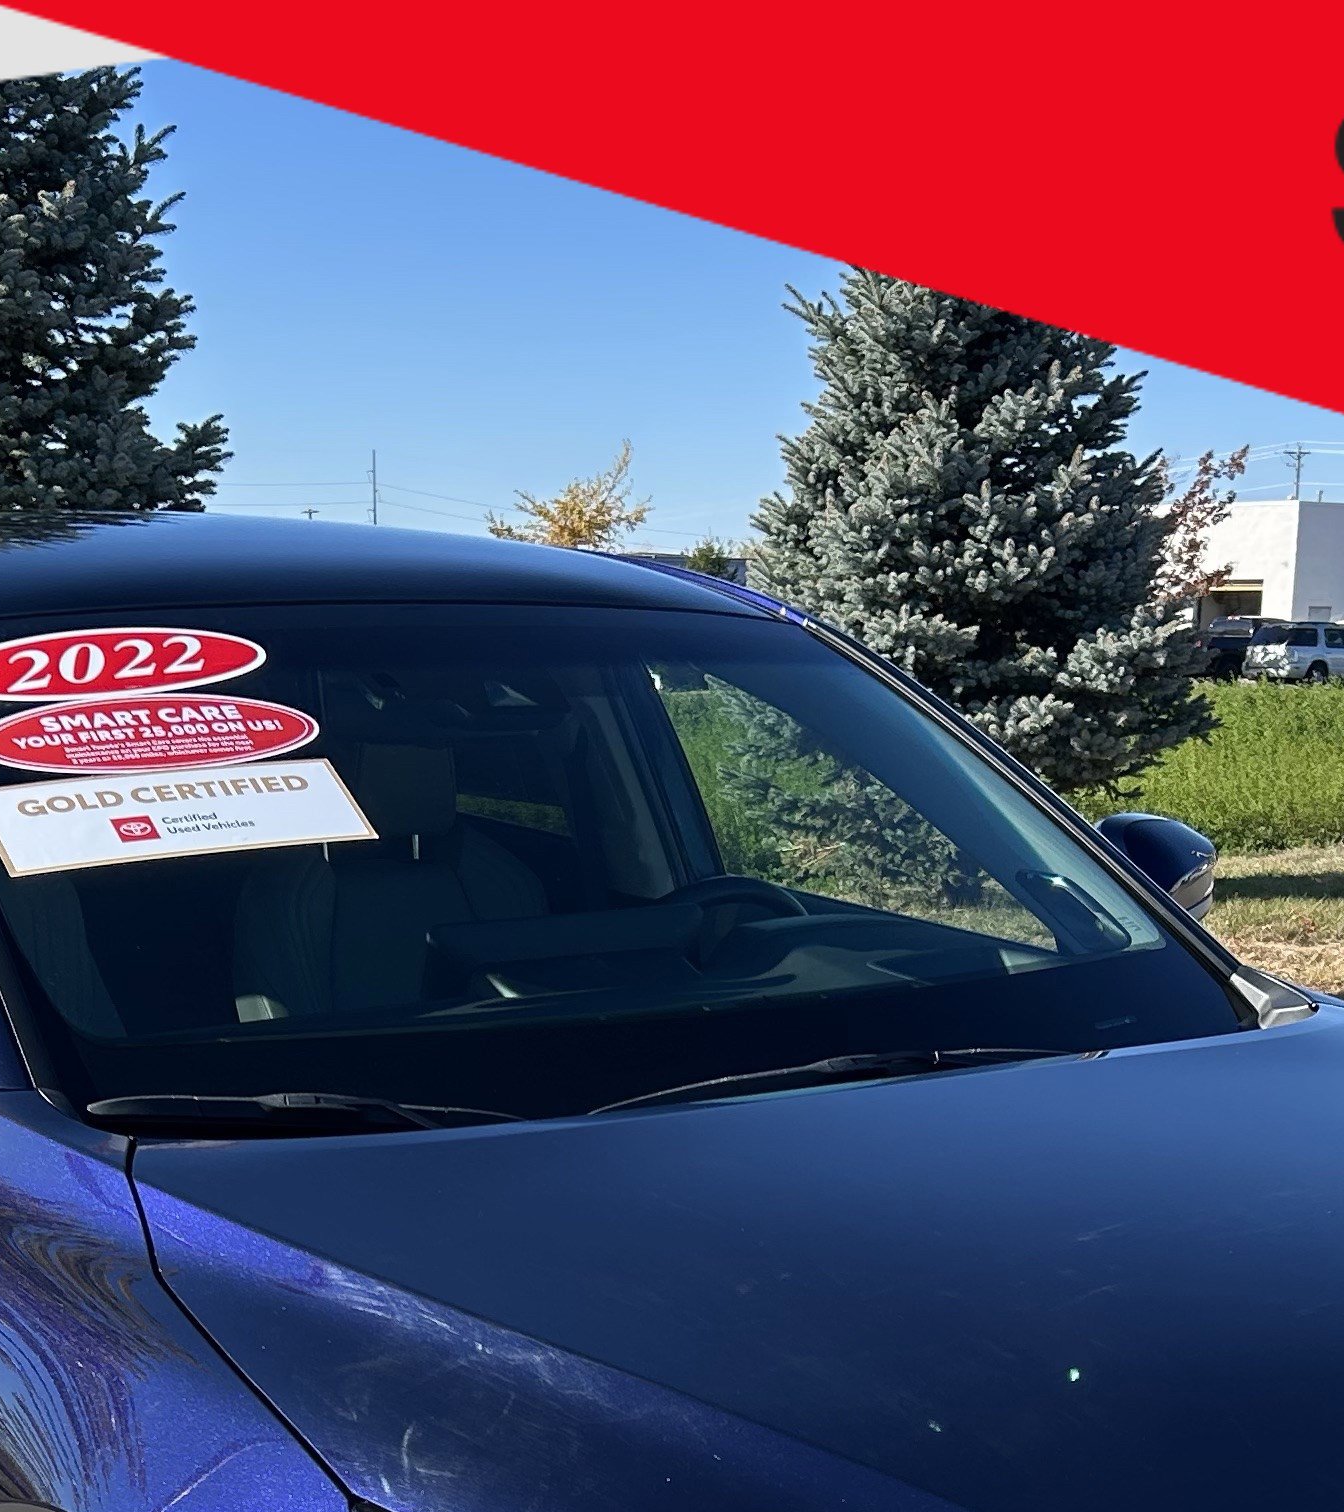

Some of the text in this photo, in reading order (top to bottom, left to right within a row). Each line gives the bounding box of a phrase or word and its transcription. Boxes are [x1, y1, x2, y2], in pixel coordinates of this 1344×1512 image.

[7, 635, 206, 693] 2022
[39, 704, 243, 733] SMART CARE
[12, 733, 78, 750] YOUR
[77, 727, 135, 743] FIRST
[211, 721, 246, 733] ON
[246, 719, 284, 731] US!
[17, 774, 309, 817] GOLD CERTIFIED
[161, 812, 218, 825] Certified
[167, 818, 256, 835] Used Vehicles
